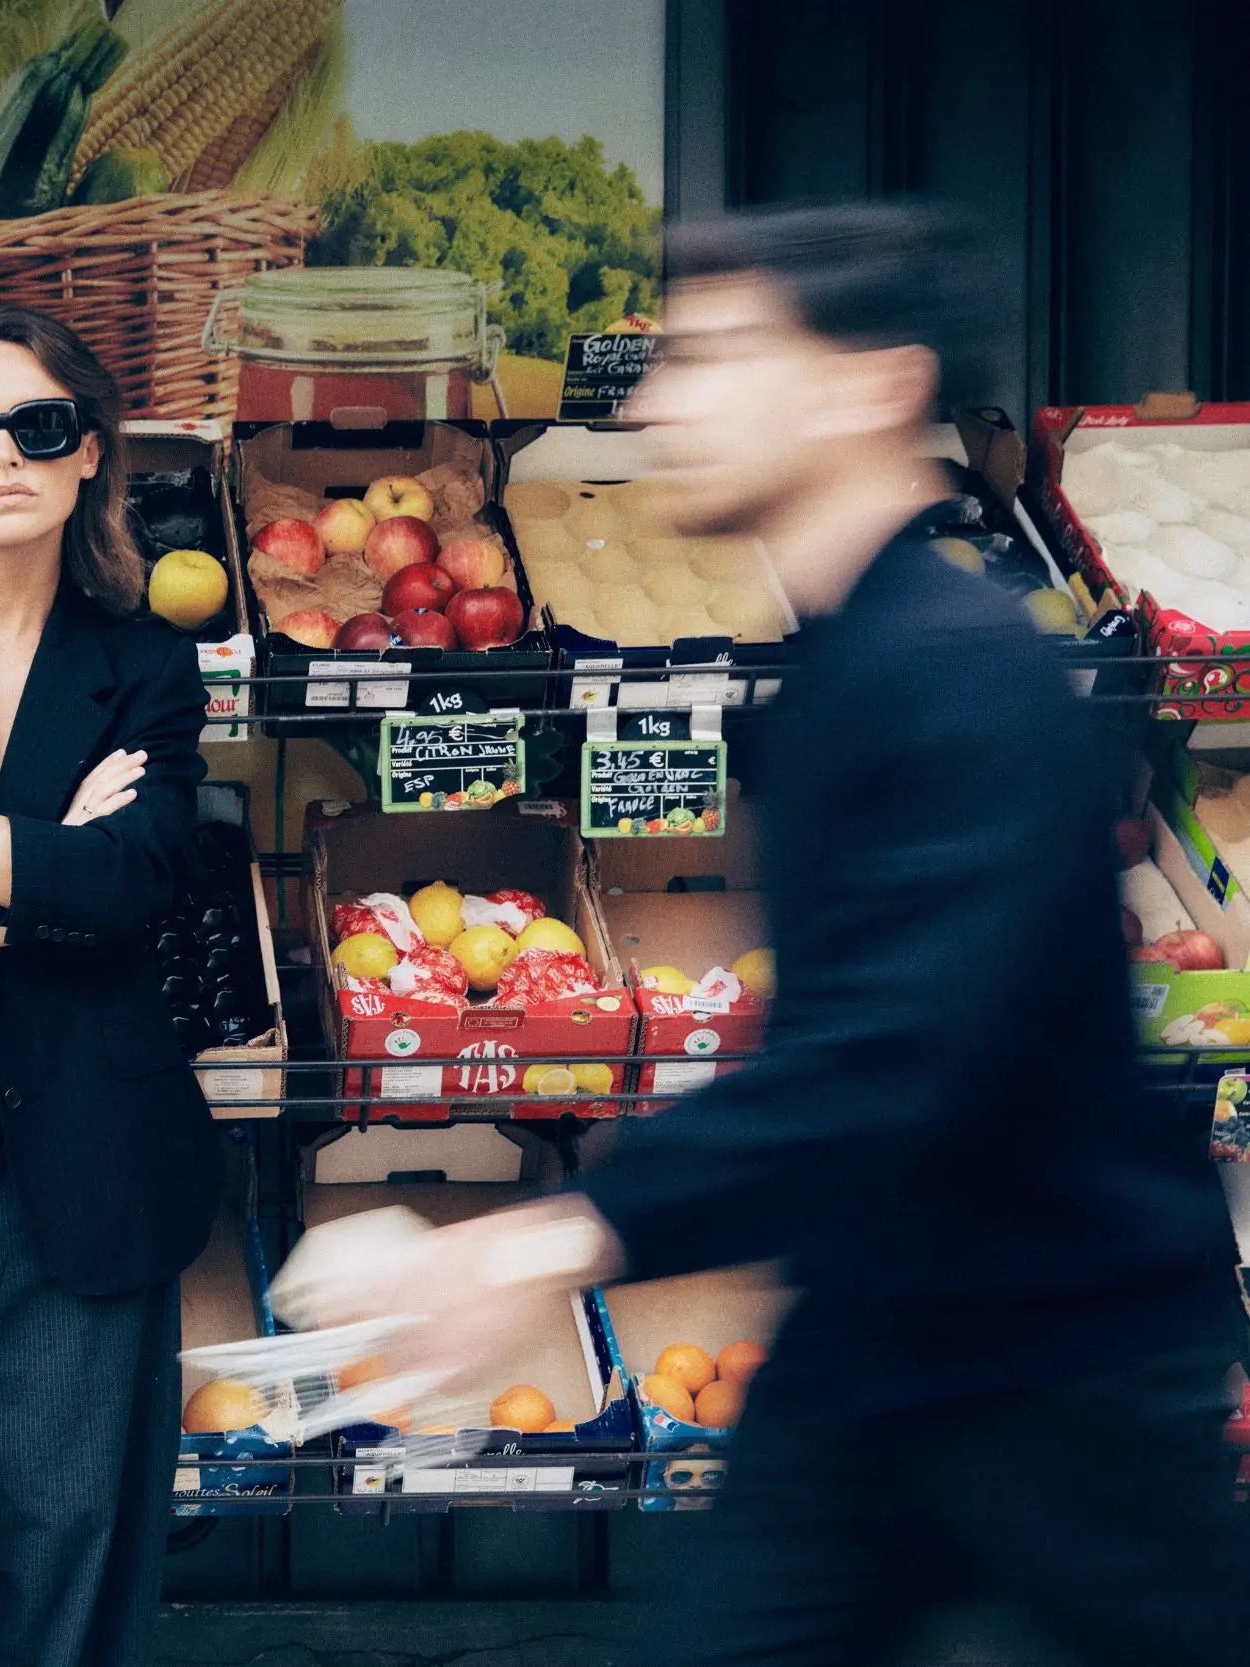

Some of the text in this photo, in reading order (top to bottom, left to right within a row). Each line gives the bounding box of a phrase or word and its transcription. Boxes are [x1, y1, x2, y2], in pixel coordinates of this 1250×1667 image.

[429, 692, 463, 713] 1kg
[448, 725, 464, 741] €
[638, 715, 671, 737] 1kg
[649, 752, 664, 768] €
[404, 774, 434, 792] ESP
[351, 993, 386, 1016] TAS
[453, 1040, 520, 1094] TAS
